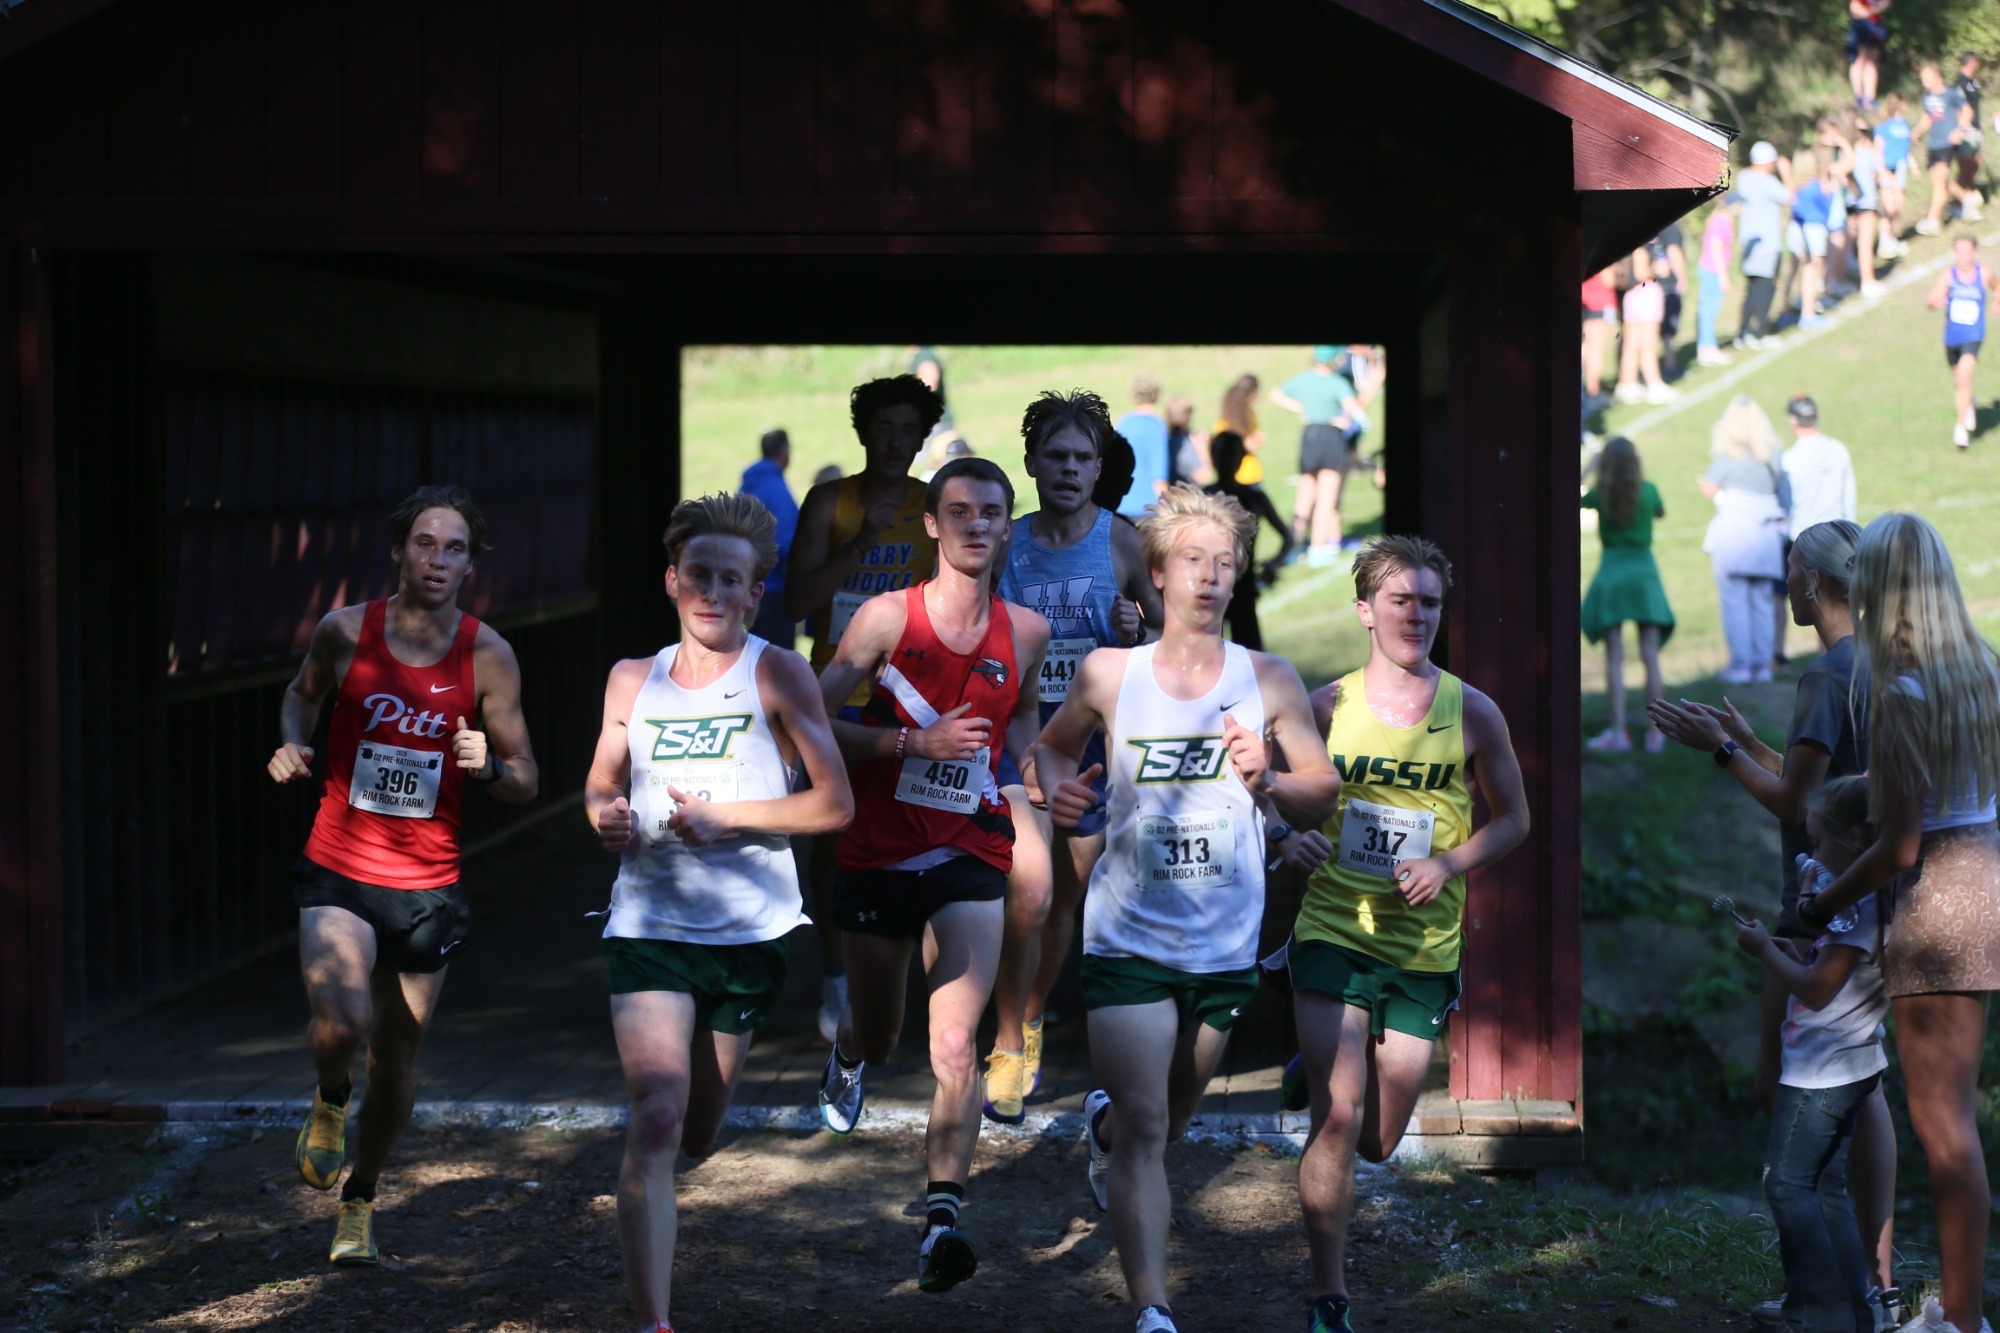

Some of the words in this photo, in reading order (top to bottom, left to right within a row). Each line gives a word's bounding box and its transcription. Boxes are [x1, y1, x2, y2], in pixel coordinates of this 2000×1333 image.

[843, 542, 920, 567] BRY-
[1030, 605, 1094, 619] SHBURN
[1046, 647, 1084, 656] RE-NATIONALS
[1040, 659, 1076, 682] 441
[1048, 683, 1068, 694] ROCK
[363, 693, 448, 739] Pitt
[650, 715, 749, 759] S&T
[374, 753, 382, 761] D2
[382, 755, 428, 769] PRE-NATIONALS
[1137, 738, 1225, 781] S&T
[374, 767, 419, 796] 396
[670, 776, 718, 785] PRE-NATIONALS
[925, 762, 969, 790] 450
[1332, 754, 1457, 791] MSSU
[362, 789, 378, 801] RIM
[378, 794, 401, 807] ROCK
[401, 798, 424, 809] FARM
[910, 783, 927, 797] RIM
[926, 787, 950, 801] ROCK
[949, 791, 972, 804] FARM
[658, 819, 675, 831] RI
[1156, 825, 1165, 834] D2
[1166, 822, 1215, 834] PRE-NATIONALS
[1360, 811, 1369, 820] D2
[1369, 814, 1417, 829] PRE-NATIONALS
[1362, 826, 1407, 856] 317
[1163, 837, 1210, 866] 313
[1350, 849, 1365, 862] RIM
[1367, 853, 1390, 868] ROCK
[1153, 868, 1170, 880] RIM
[1172, 866, 1196, 880] ROCK
[1198, 864, 1222, 878] FARM
